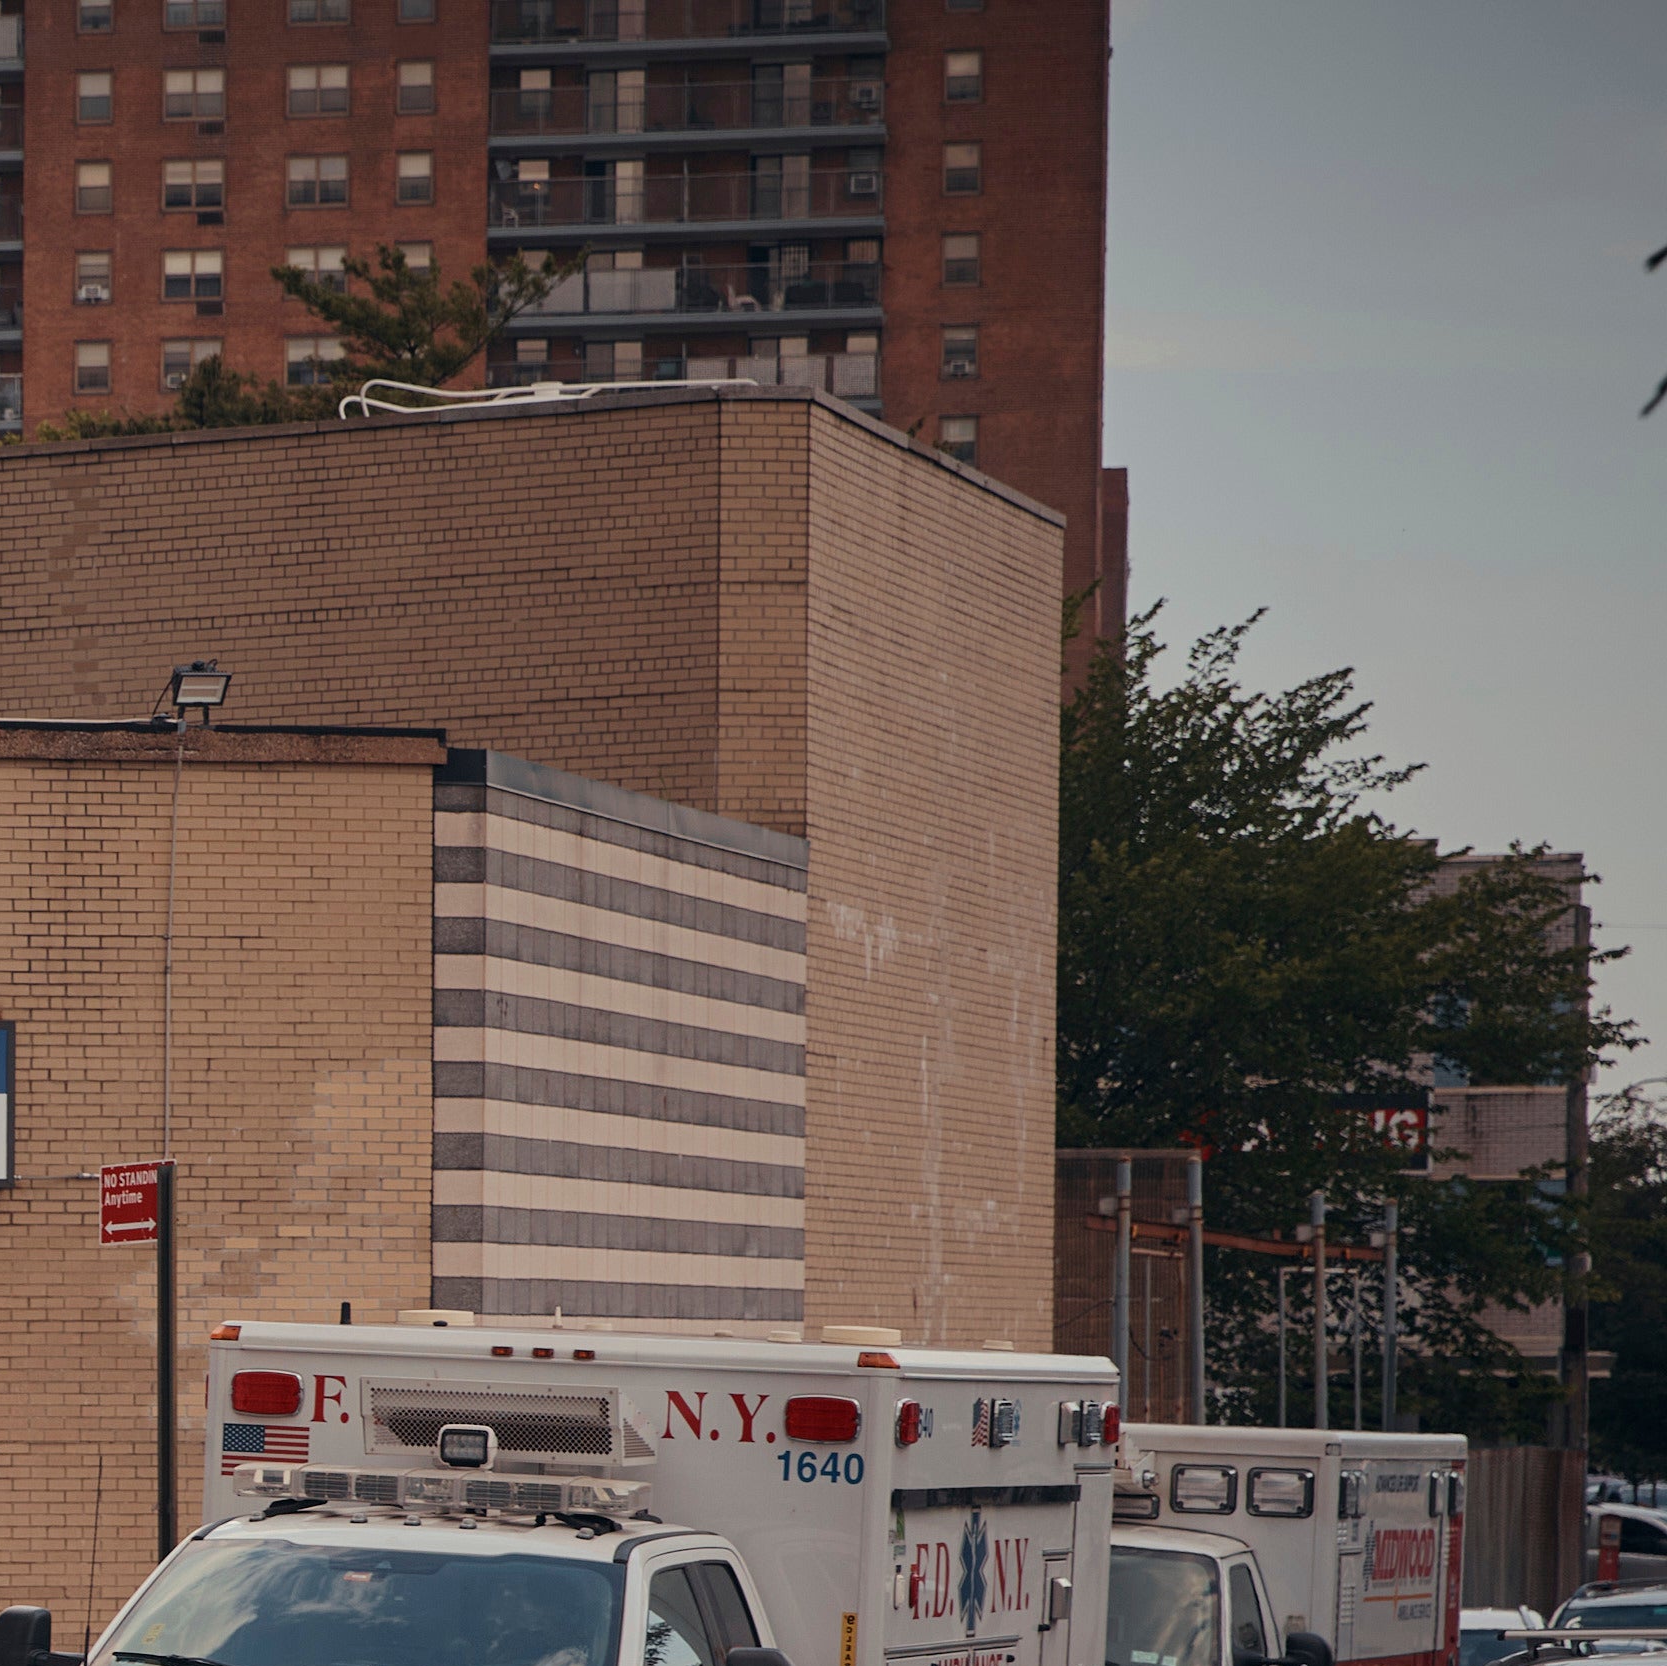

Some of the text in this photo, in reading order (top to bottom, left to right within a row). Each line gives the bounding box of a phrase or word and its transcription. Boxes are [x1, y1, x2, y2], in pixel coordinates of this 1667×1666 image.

[104, 1169, 158, 1188] NO STANDIN
[104, 1190, 143, 1208] Anytime
[778, 1450, 865, 1486] 1640
